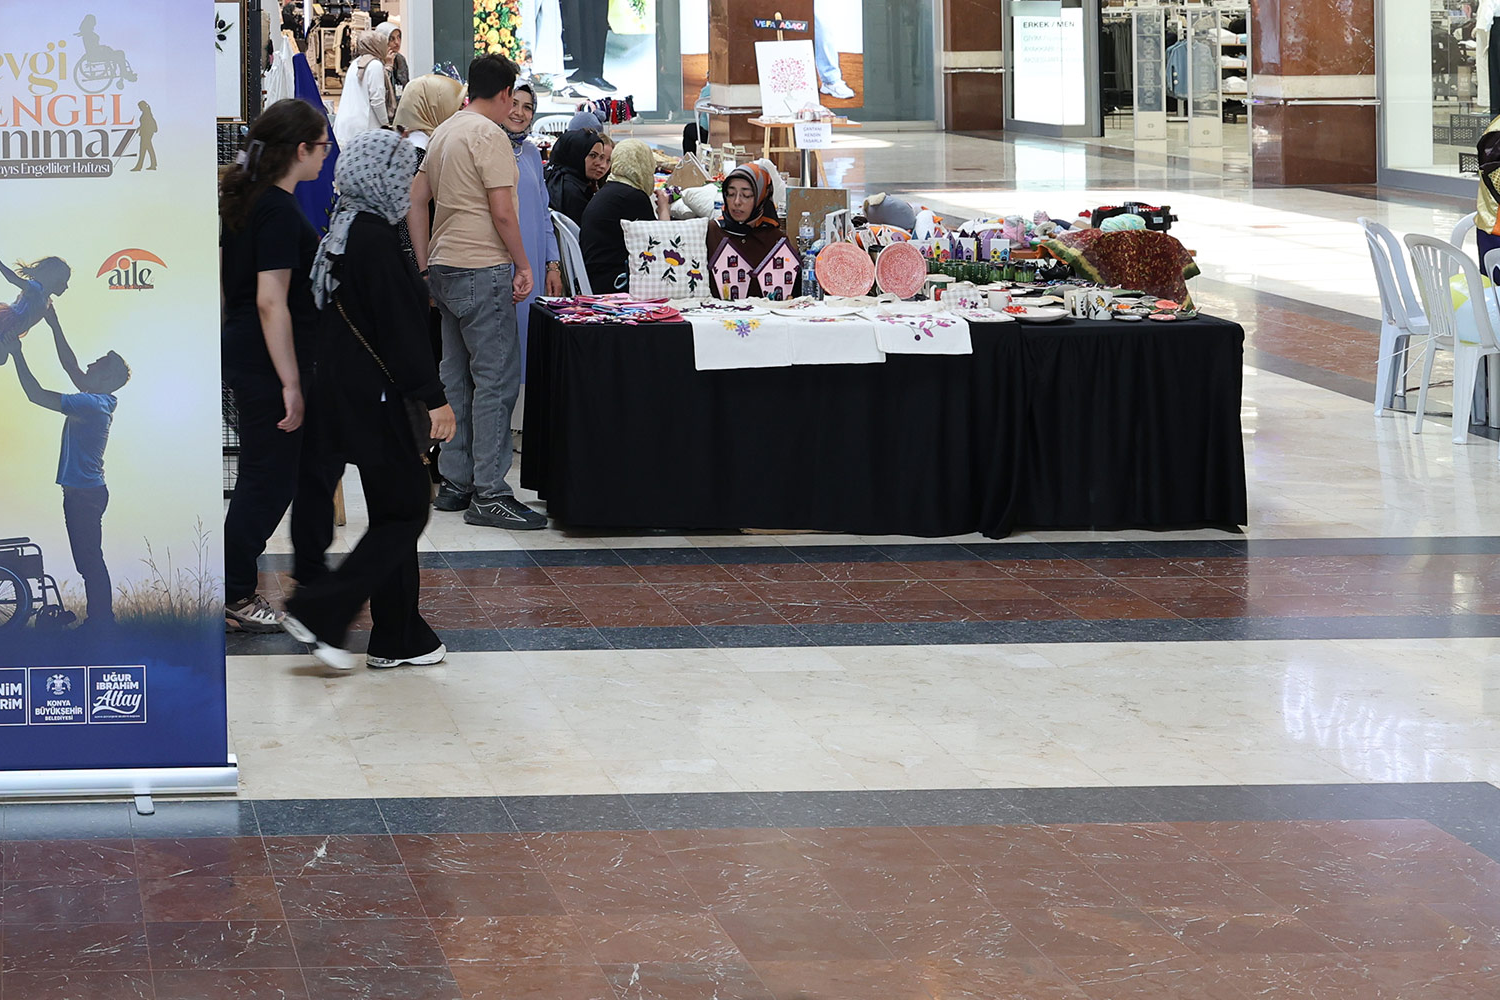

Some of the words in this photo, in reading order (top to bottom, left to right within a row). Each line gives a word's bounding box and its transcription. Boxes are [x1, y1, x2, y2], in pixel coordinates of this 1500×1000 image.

[20, 162, 71, 177] Engelliler
[102, 672, 132, 682] UĞUR
[96, 681, 139, 690] İBRAHİM
[92, 689, 143, 715] Altay
[35, 705, 83, 716] BÜYÜKŞEHİR
